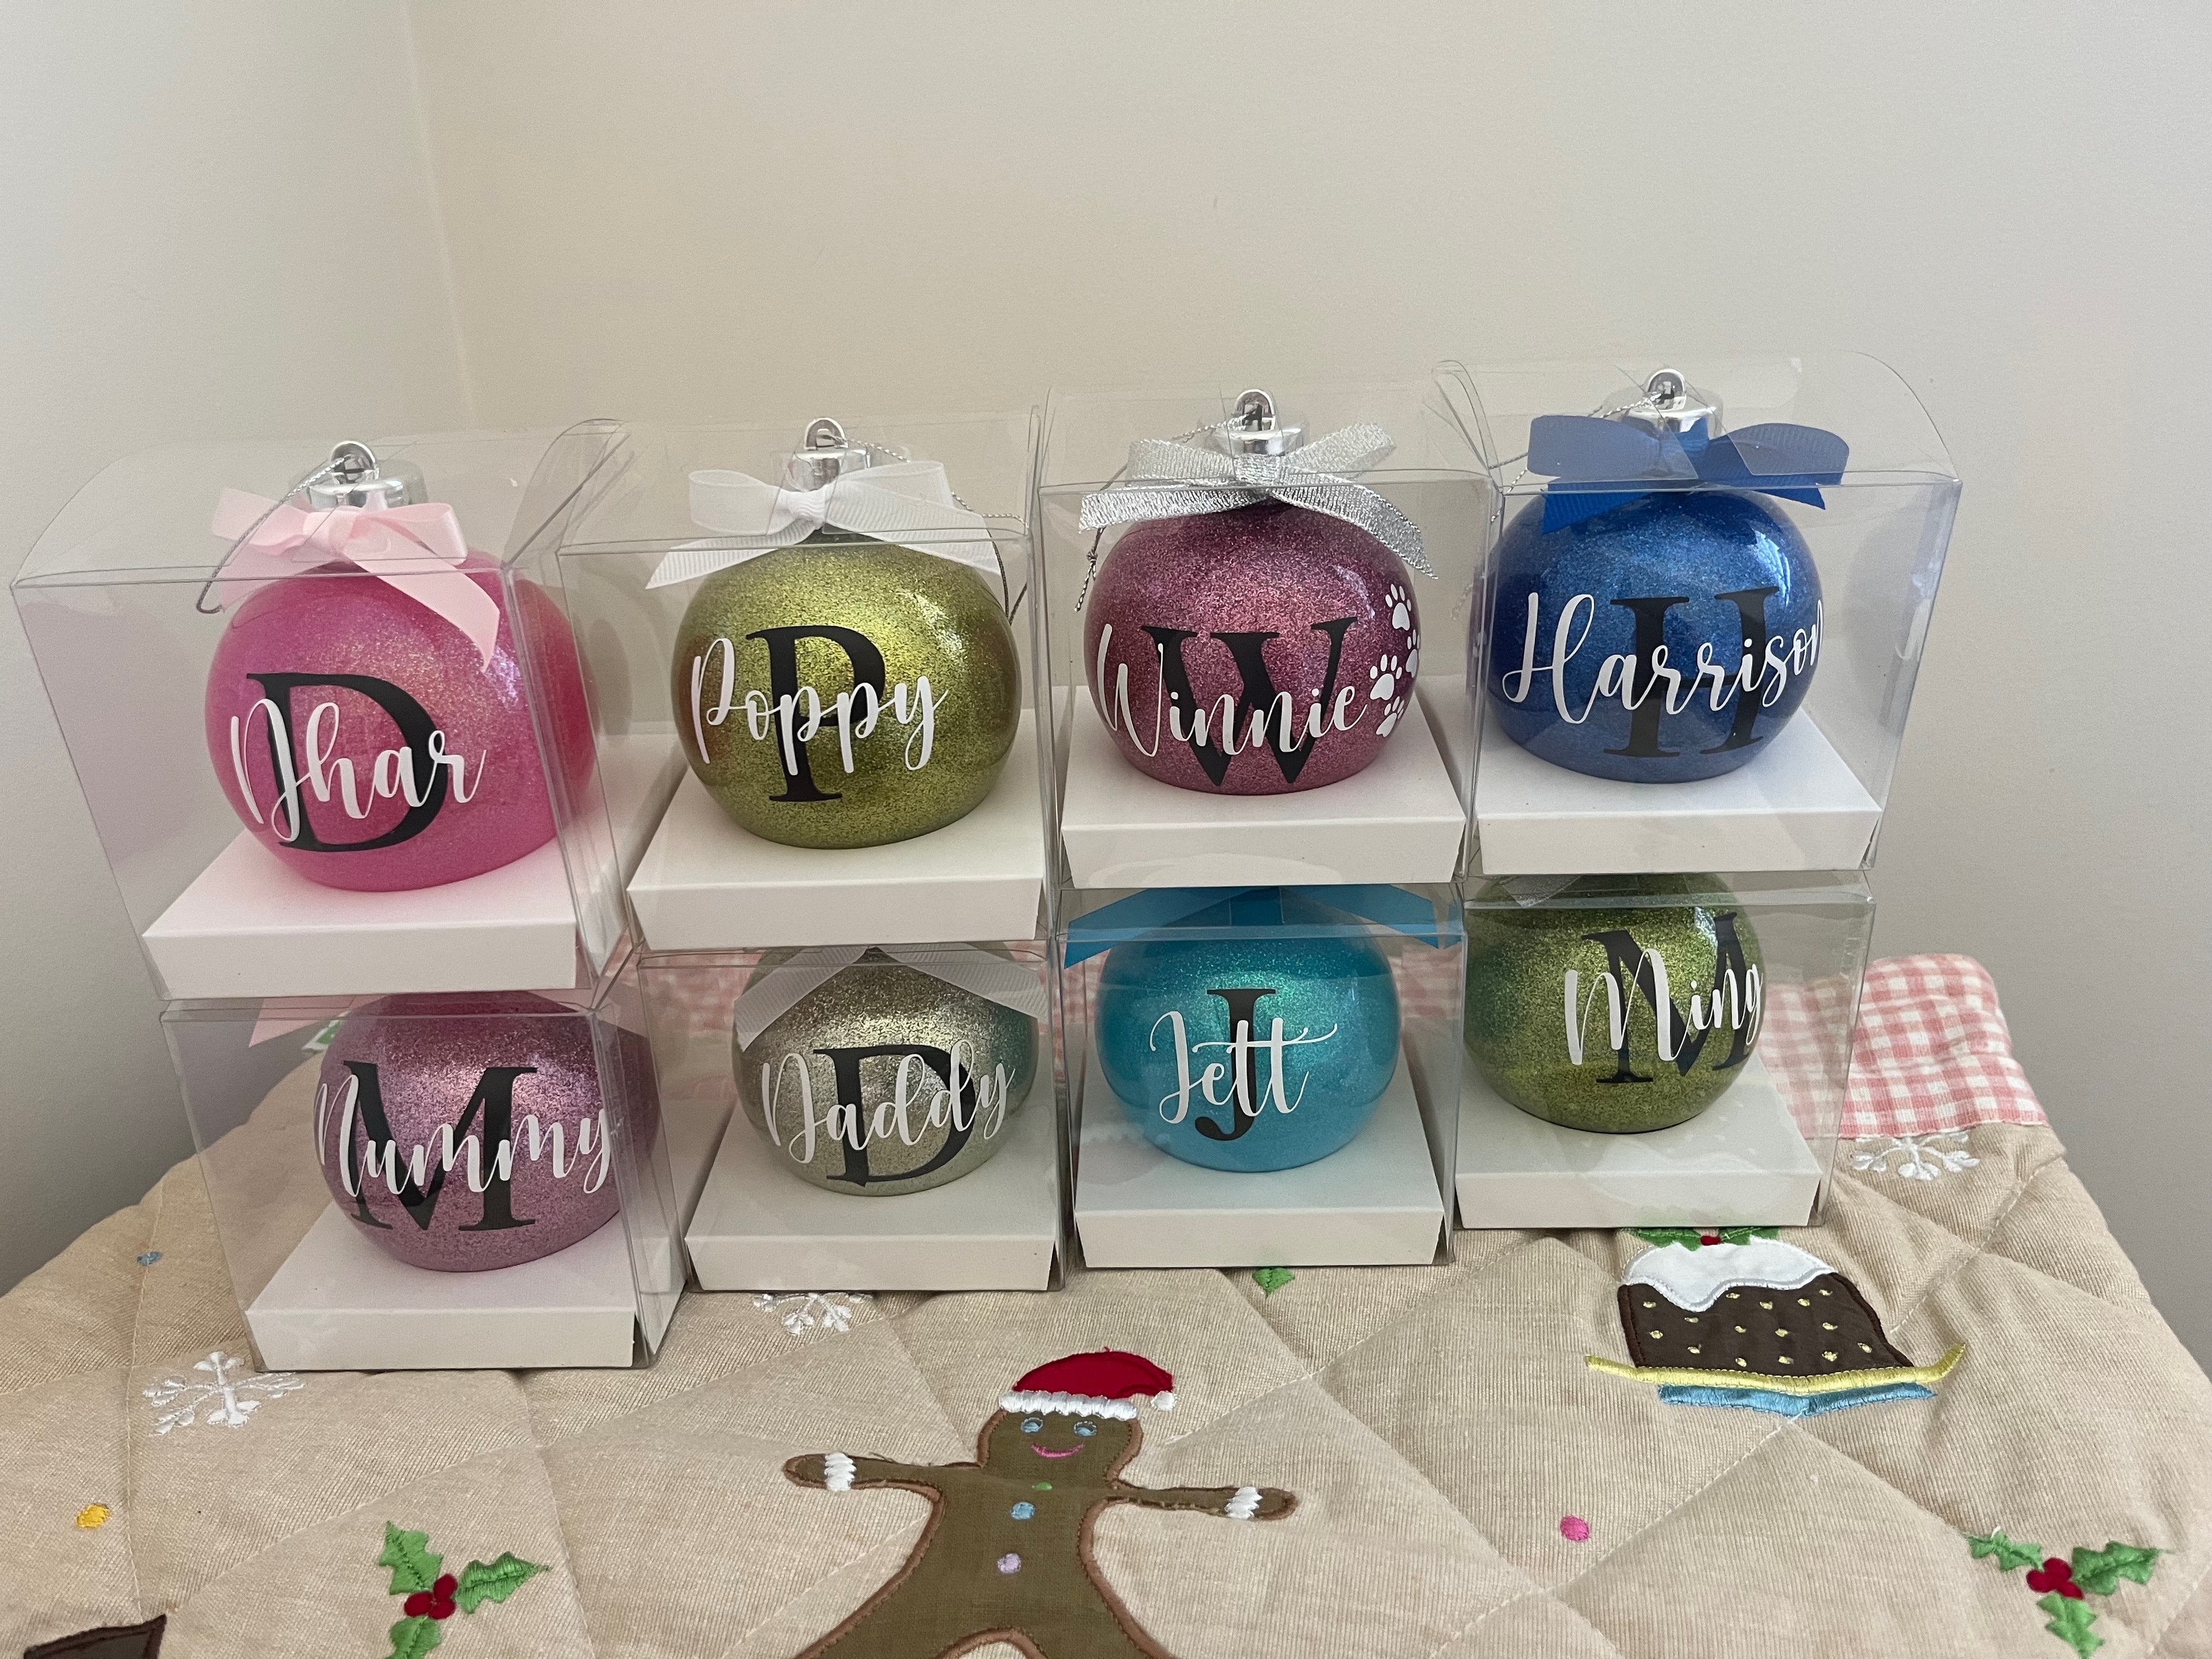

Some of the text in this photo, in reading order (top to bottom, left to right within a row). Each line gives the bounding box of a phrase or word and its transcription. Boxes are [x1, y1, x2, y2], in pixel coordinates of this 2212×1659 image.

[691, 637, 949, 775] Poppy
[746, 625, 885, 802] P
[1097, 624, 1368, 757] Winnie
[1141, 616, 1357, 786] W
[1502, 592, 1824, 724] Harrison
[1604, 586, 1779, 758] H
[230, 698, 487, 841] Dhar
[247, 673, 448, 853] D
[1149, 1011, 1338, 1124] Jett
[1195, 989, 1276, 1141] J
[1565, 949, 1763, 1065] Ming
[1581, 912, 1750, 1083] M
[314, 1074, 613, 1197] Mummy
[343, 1060, 538, 1231] M
[761, 1040, 1015, 1163] Daddy
[813, 1043, 976, 1187] D
